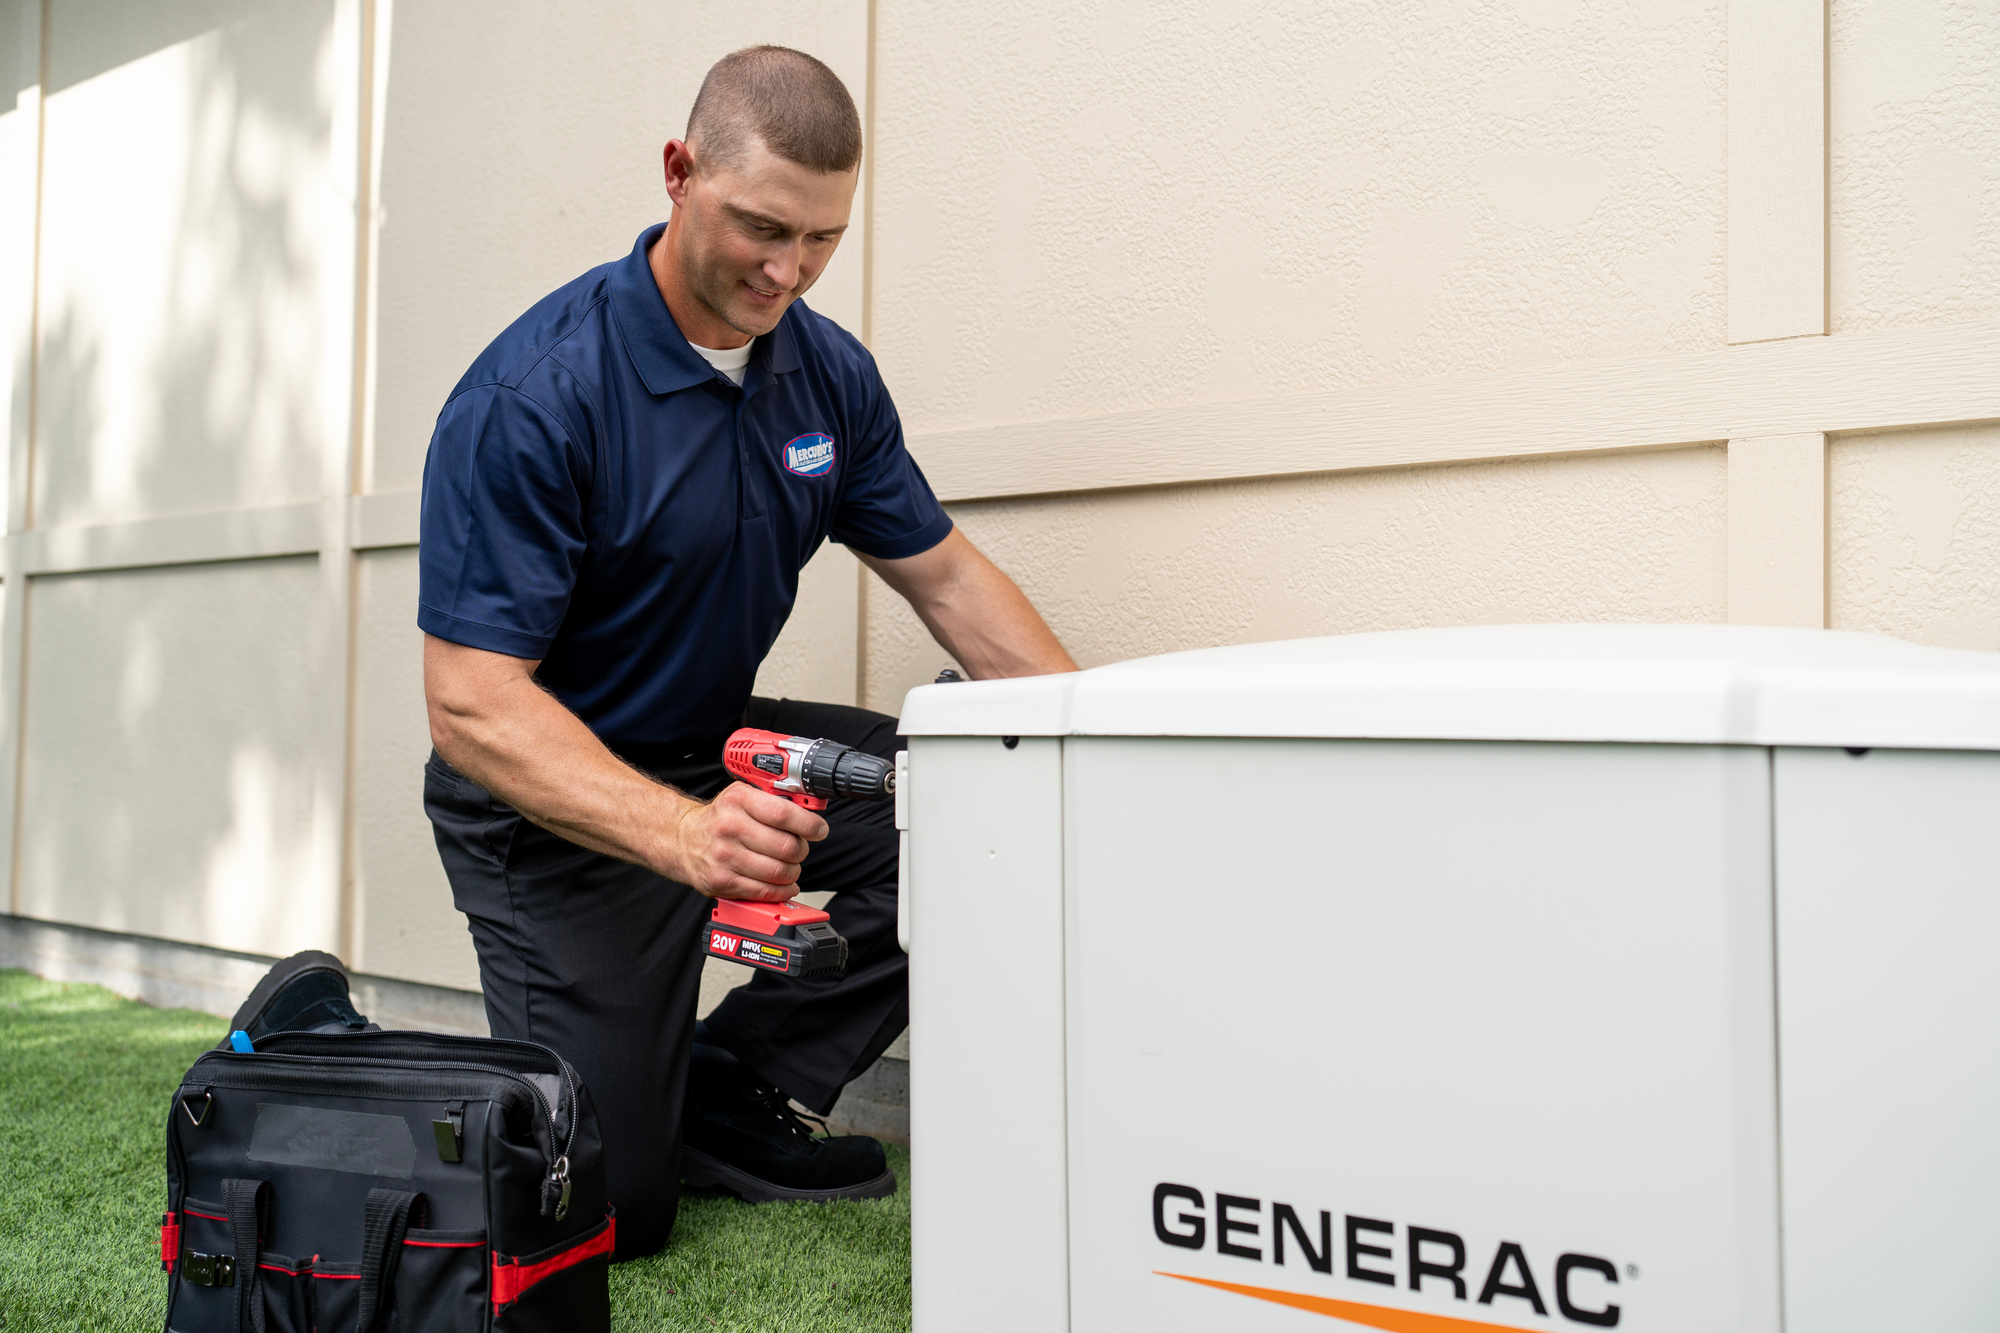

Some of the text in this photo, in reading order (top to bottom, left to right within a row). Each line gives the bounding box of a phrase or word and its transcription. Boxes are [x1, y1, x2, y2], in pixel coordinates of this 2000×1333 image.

[712, 934, 737, 952] 20V
[742, 940, 761, 953] MAX
[1152, 1182, 1620, 1328] GENERAC
